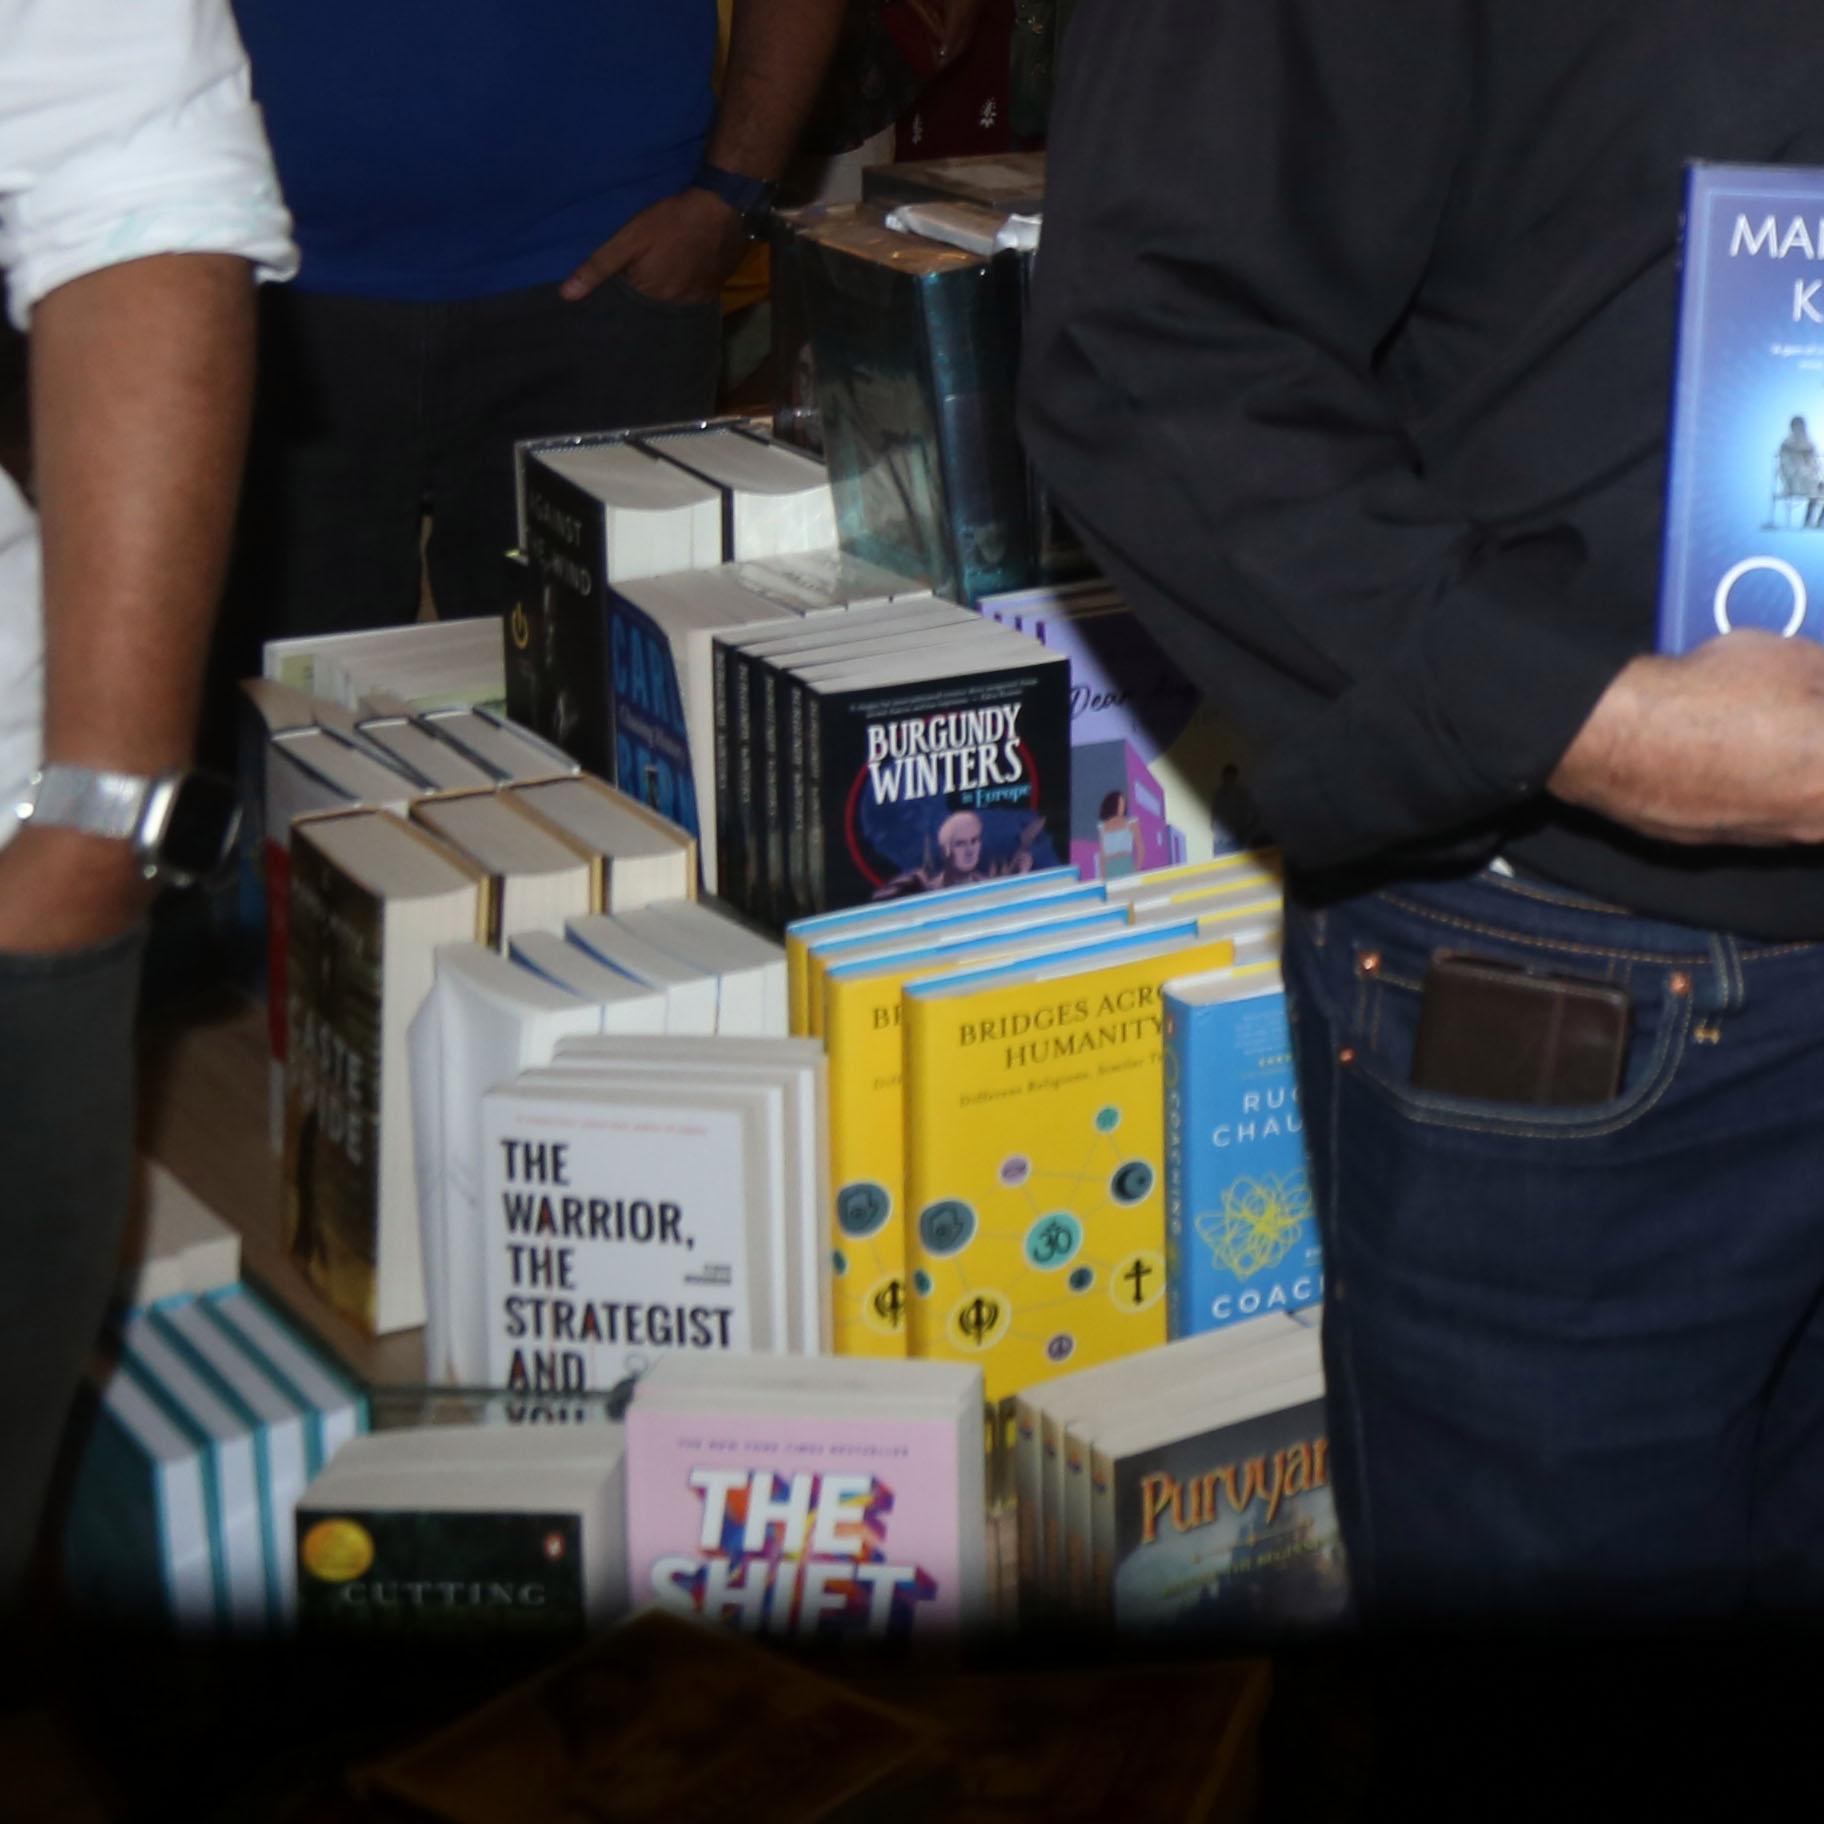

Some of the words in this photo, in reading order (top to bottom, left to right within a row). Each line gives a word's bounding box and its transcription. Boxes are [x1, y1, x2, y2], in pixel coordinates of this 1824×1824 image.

[868, 702, 1022, 763] BURGUNDY
[868, 738, 1023, 806] WINTERS
[976, 783, 1032, 809] Europe
[958, 1001, 1089, 1048] BRIDGES
[1004, 1016, 1163, 1070] HUMANITY
[500, 1137, 570, 1187] THE
[502, 1191, 695, 1251] WARRIOR,
[506, 1242, 576, 1291] THE
[504, 1295, 735, 1350] STRATEGIST
[506, 1347, 588, 1399] AND
[688, 1466, 894, 1561] THE
[341, 1580, 547, 1608] CUTTING
[648, 1554, 936, 1638] SHIFT
